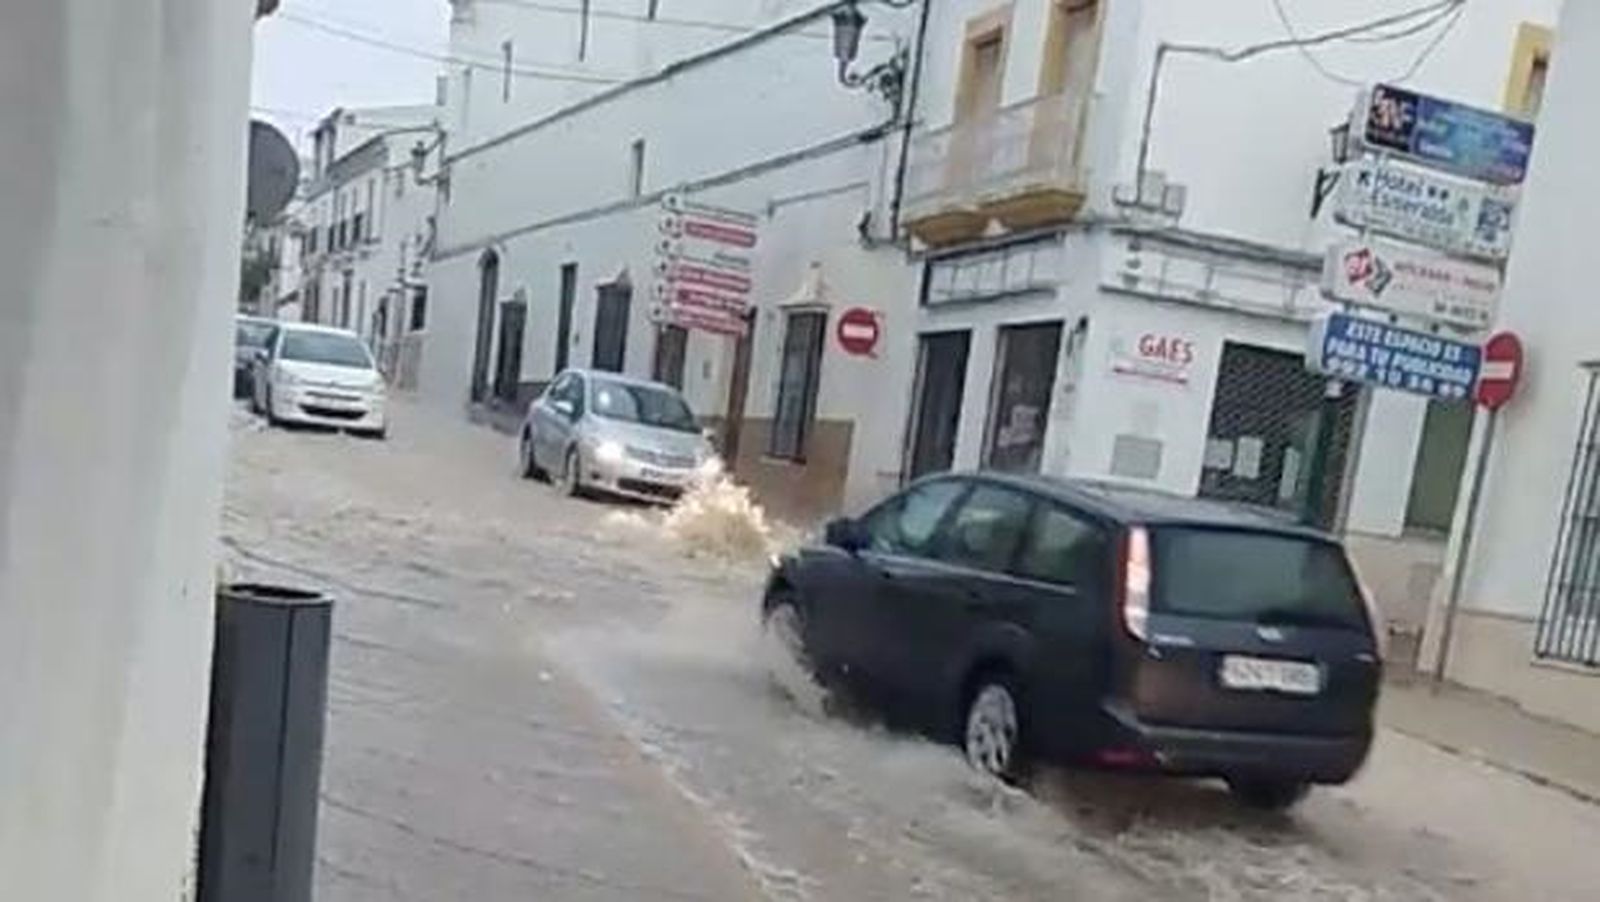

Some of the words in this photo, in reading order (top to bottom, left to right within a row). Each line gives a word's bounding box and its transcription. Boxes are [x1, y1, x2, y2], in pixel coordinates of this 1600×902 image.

[1375, 168, 1423, 196] Hotel
[1139, 333, 1193, 363] GAES
[1346, 321, 1381, 342] ESTE
[1384, 329, 1441, 356] ESPACIO
[1443, 343, 1462, 362] ES
[1326, 338, 1367, 359] PARA
[1371, 346, 1391, 365] TU
[1392, 352, 1472, 385] PUBLICIDAD
